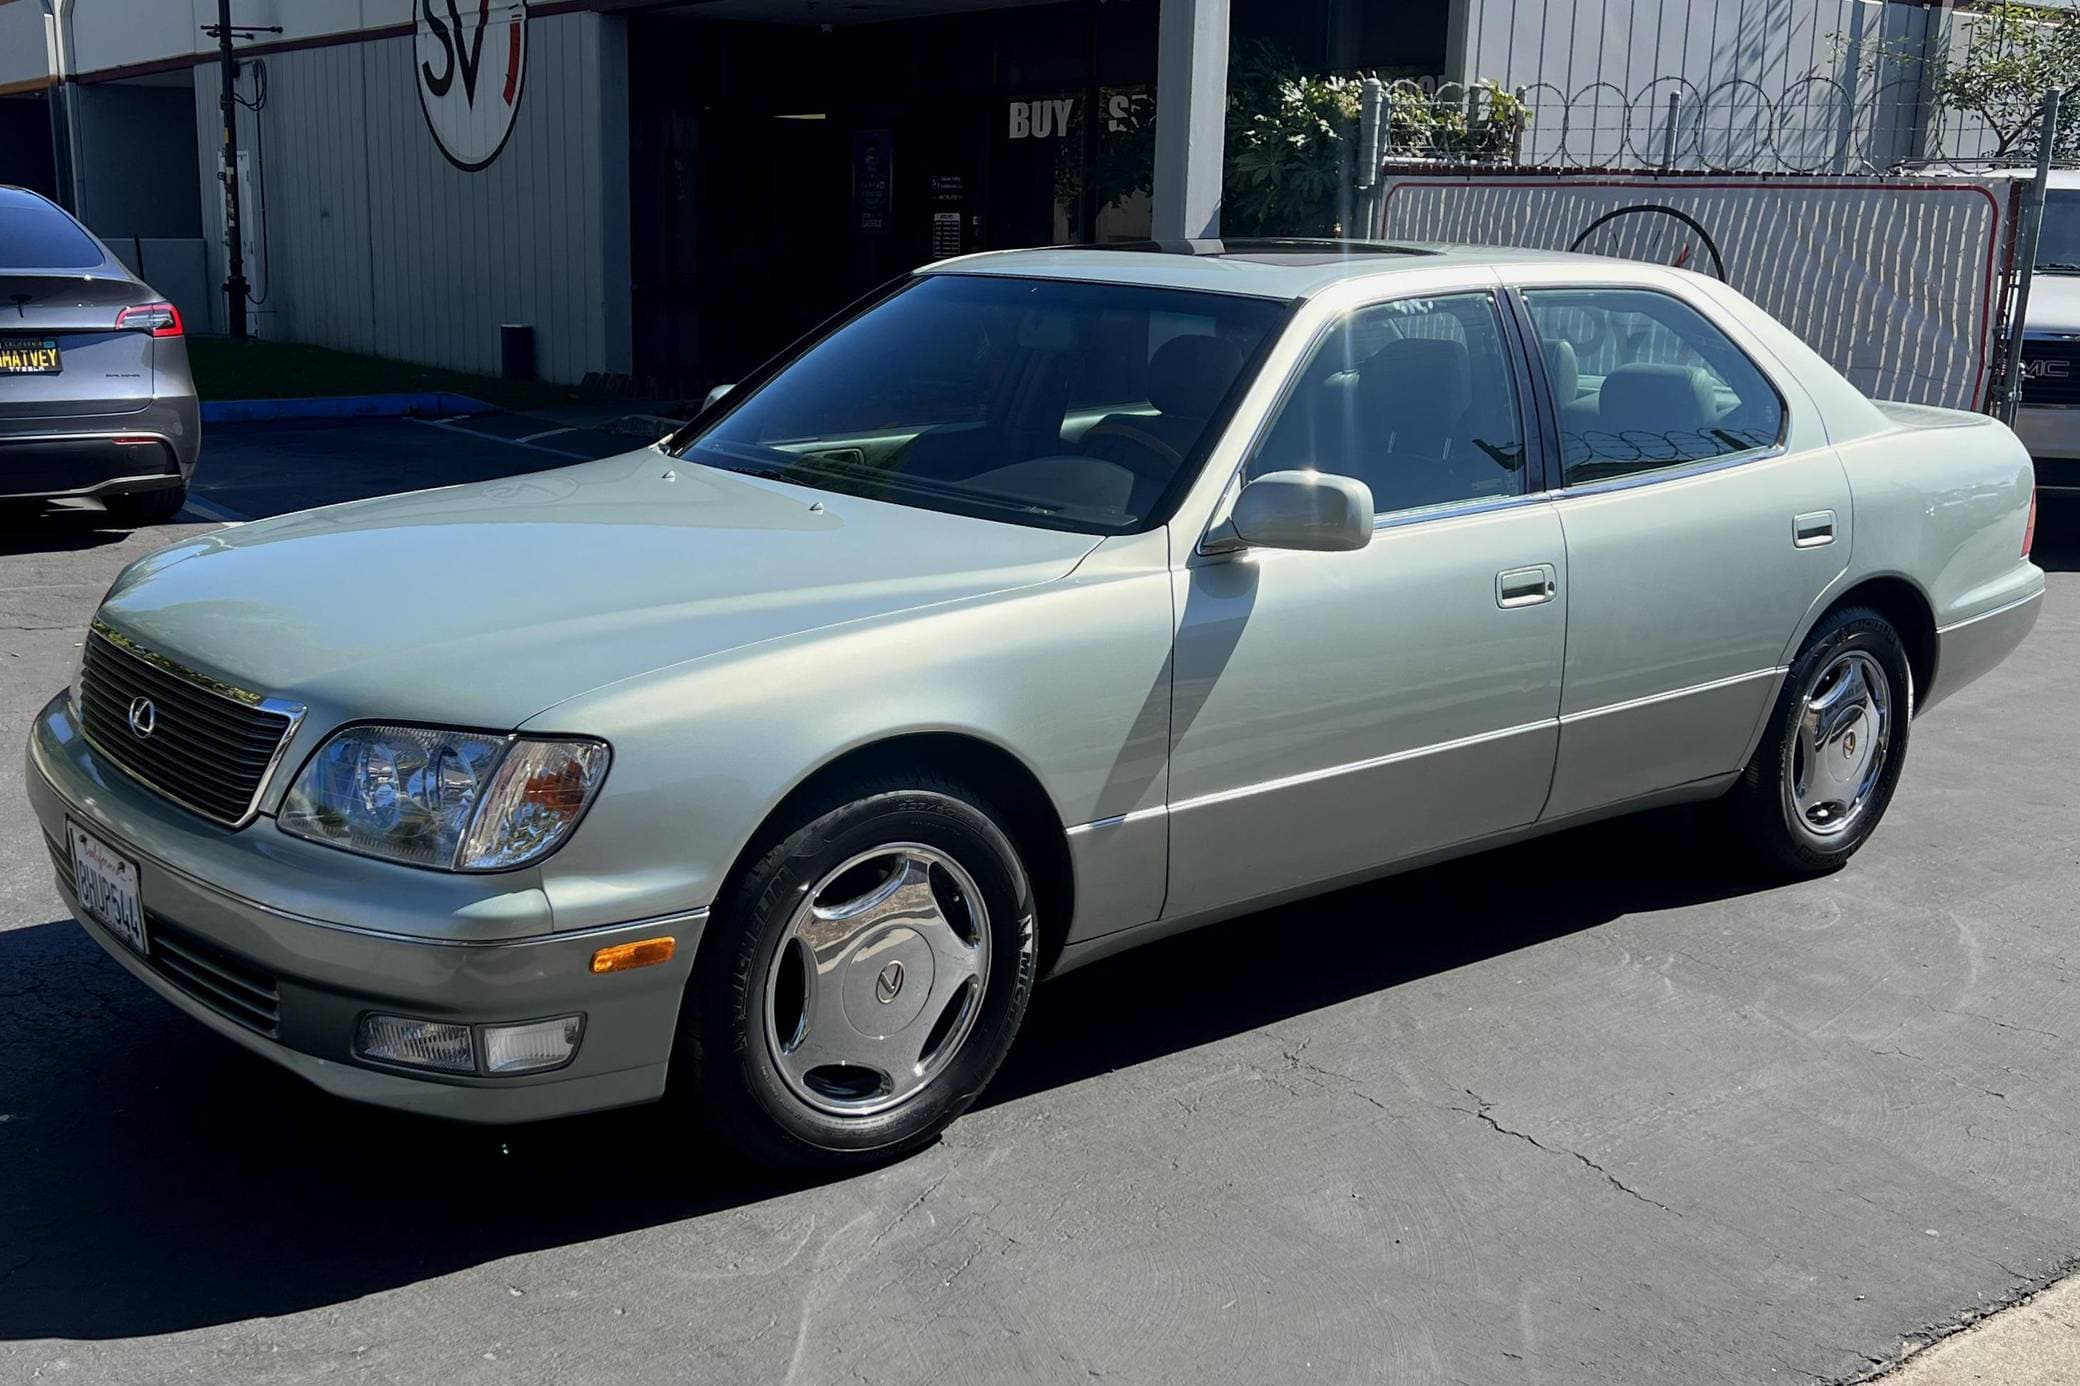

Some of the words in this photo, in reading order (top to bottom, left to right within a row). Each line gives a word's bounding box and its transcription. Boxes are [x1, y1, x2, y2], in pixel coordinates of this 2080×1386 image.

[1008, 98, 1074, 139] BUY
[2018, 359, 2071, 378] MC
[78, 860, 140, 939] 8HUP544
